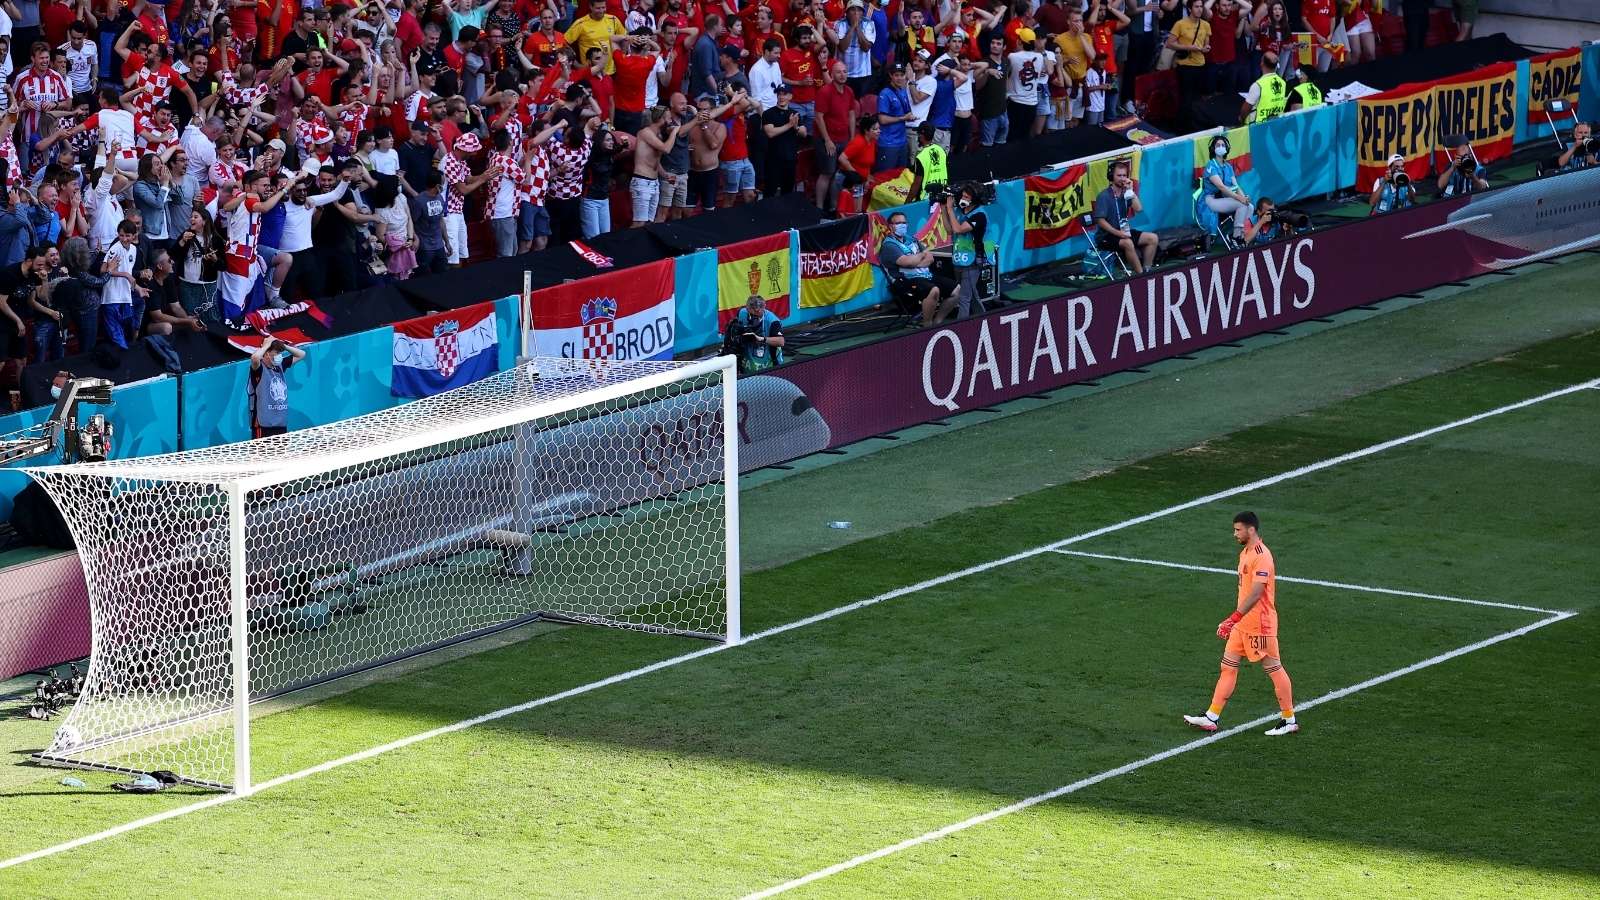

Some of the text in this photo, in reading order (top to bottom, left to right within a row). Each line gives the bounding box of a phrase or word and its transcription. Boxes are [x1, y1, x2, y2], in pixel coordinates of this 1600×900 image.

[1532, 59, 1581, 102] CÁDIZ
[1361, 102, 1410, 161] PEPE
[615, 316, 673, 361] BROD
[922, 238, 1316, 411] QATAR AIRWAYS
